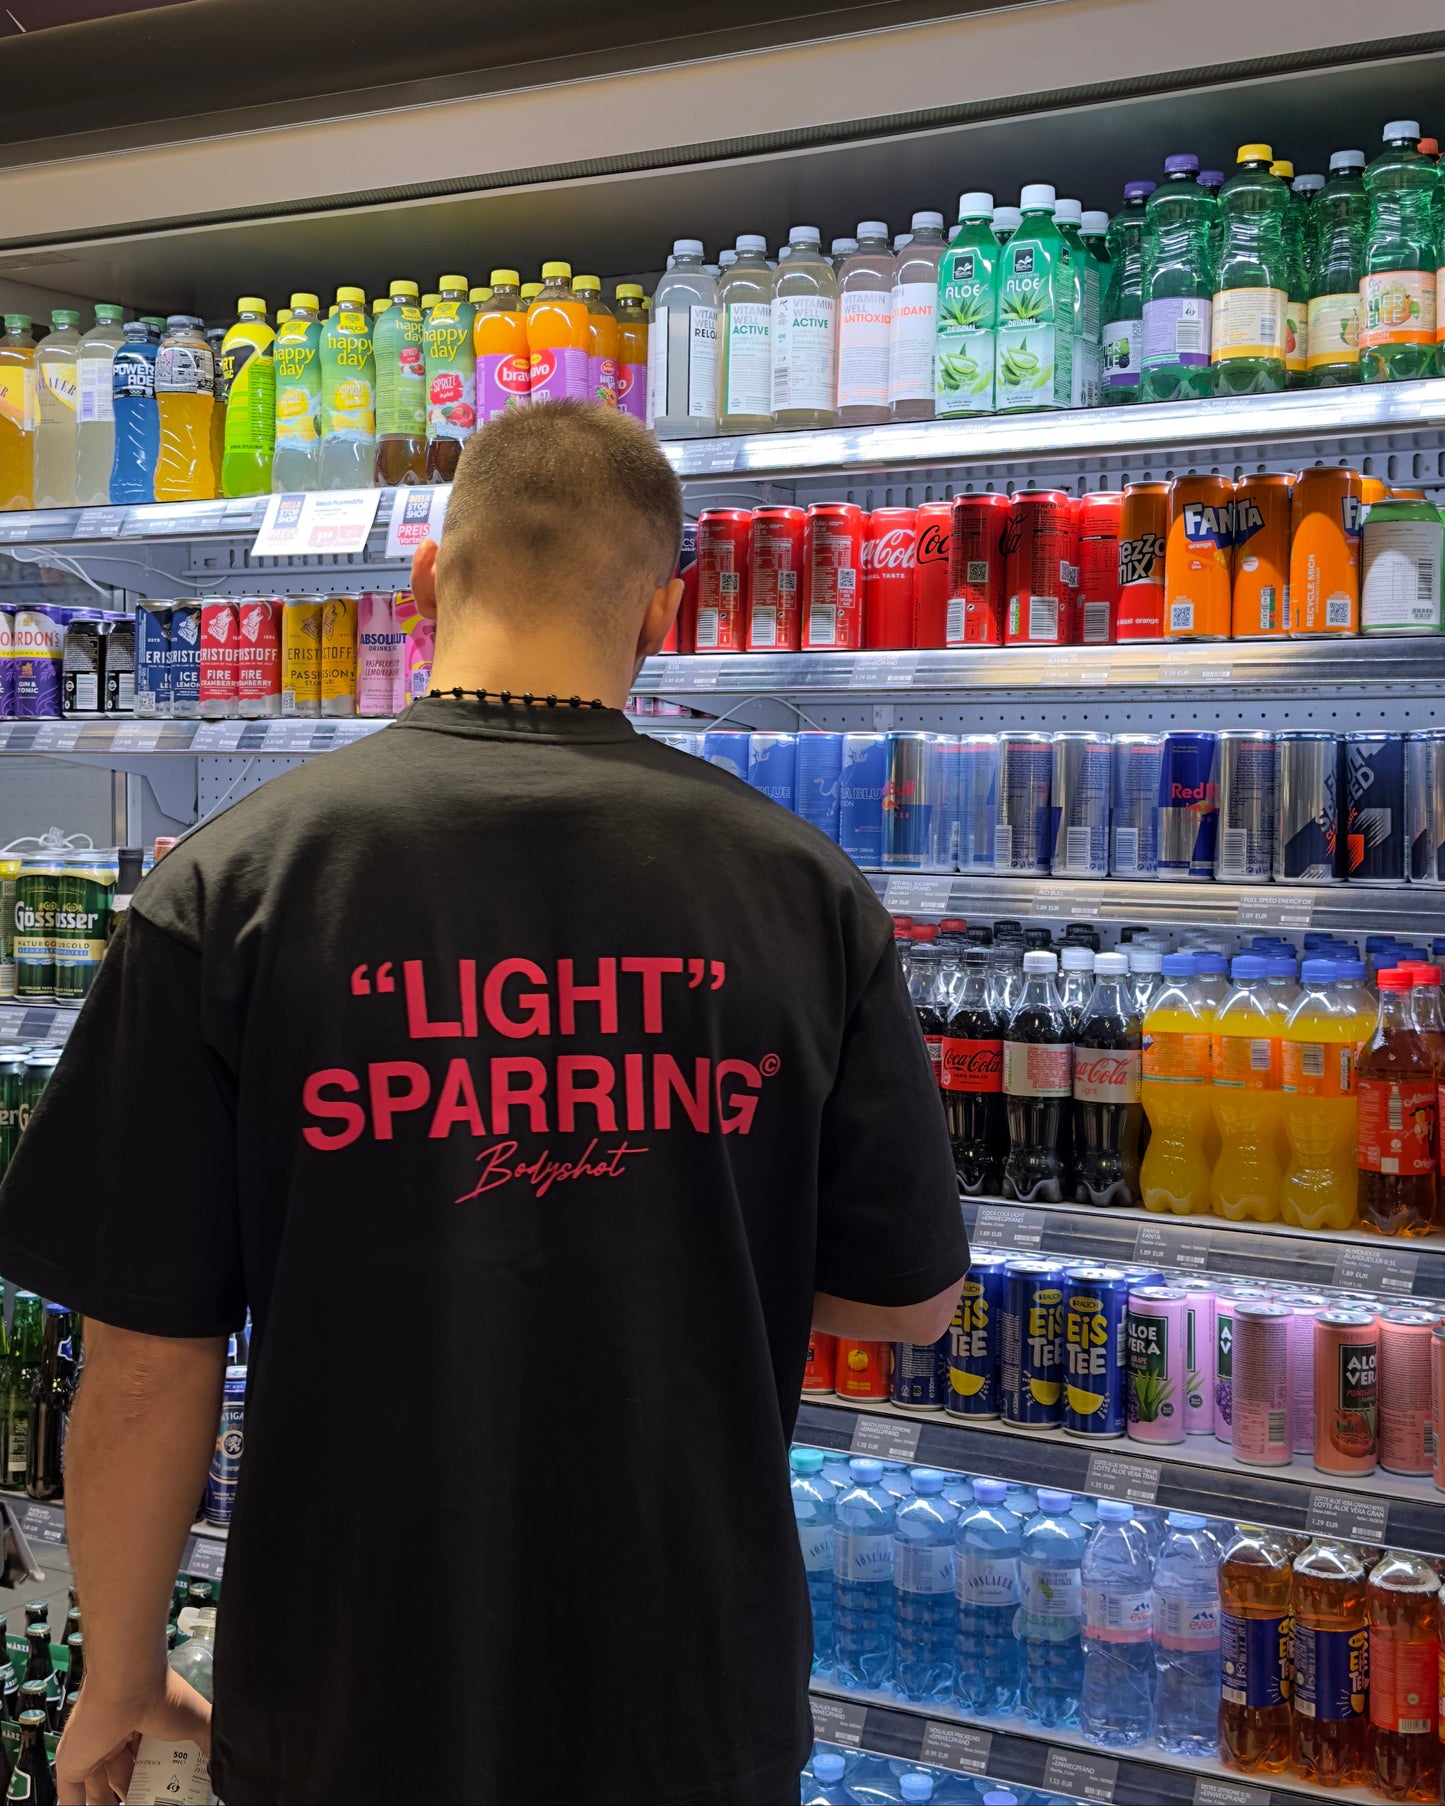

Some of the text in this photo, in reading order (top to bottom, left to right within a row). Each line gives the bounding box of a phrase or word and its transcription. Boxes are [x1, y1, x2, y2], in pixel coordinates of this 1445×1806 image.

[1006, 278, 1040, 292] ALOE
[946, 284, 980, 299] ALOE
[793, 299, 833, 310] VITAMIN
[845, 294, 885, 304] VITAMIN
[793, 308, 820, 318] WELL
[844, 304, 867, 313] WELL
[734, 316, 760, 324] WELL
[792, 318, 829, 328] ACTIVE
[843, 313, 892, 324] ANTIOXID
[1008, 318, 1036, 326] ORIGINAL
[732, 325, 769, 336] ACTIVE
[948, 324, 976, 332] ORIGINAL
[424, 328, 468, 345] happy
[694, 328, 717, 340] RELO
[328, 333, 373, 355] happy
[430, 341, 458, 362] day
[337, 350, 368, 371] day
[112, 364, 154, 376] POWER
[280, 361, 306, 380] day
[503, 368, 531, 382] brav
[128, 376, 154, 386] ADE
[434, 376, 456, 392] SPRIZZ
[280, 508, 300, 516] STOP
[407, 502, 428, 511] STOP
[406, 509, 427, 518] SHOP
[278, 516, 297, 524] SHOP
[398, 525, 430, 537] PREIS
[1119, 534, 1165, 563] ezzo
[1306, 554, 1314, 628] RECYCLE MICH
[288, 648, 320, 660] ERIST
[180, 672, 198, 682] ICE
[207, 670, 231, 680] FIRE
[241, 670, 262, 680] FIRE
[1172, 782, 1204, 799] Red
[15, 901, 55, 932] Göss
[454, 1138, 649, 1204] Bodyshot
[1355, 1271, 1368, 1279] EUR
[1073, 1300, 1100, 1309] RAUCH
[951, 1330, 988, 1358] TEE
[1066, 1346, 1107, 1375] TEE
[1347, 1355, 1376, 1370] ALO
[1346, 1370, 1376, 1386] VER
[1093, 1464, 1111, 1474] LOTTE
[1112, 1467, 1126, 1476] ALOE
[1128, 1470, 1142, 1478] VERA
[1313, 1501, 1385, 1518] LOTTE ALOE VERA GRAN
[1312, 1518, 1338, 1528] 1.29 EUR
[1130, 1612, 1150, 1622] evia
[1188, 1617, 1217, 1631] evian
[6, 1642, 30, 1653] MÄRZ
[174, 1751, 188, 1760] 500
[1061, 1780, 1072, 1788] EUR
